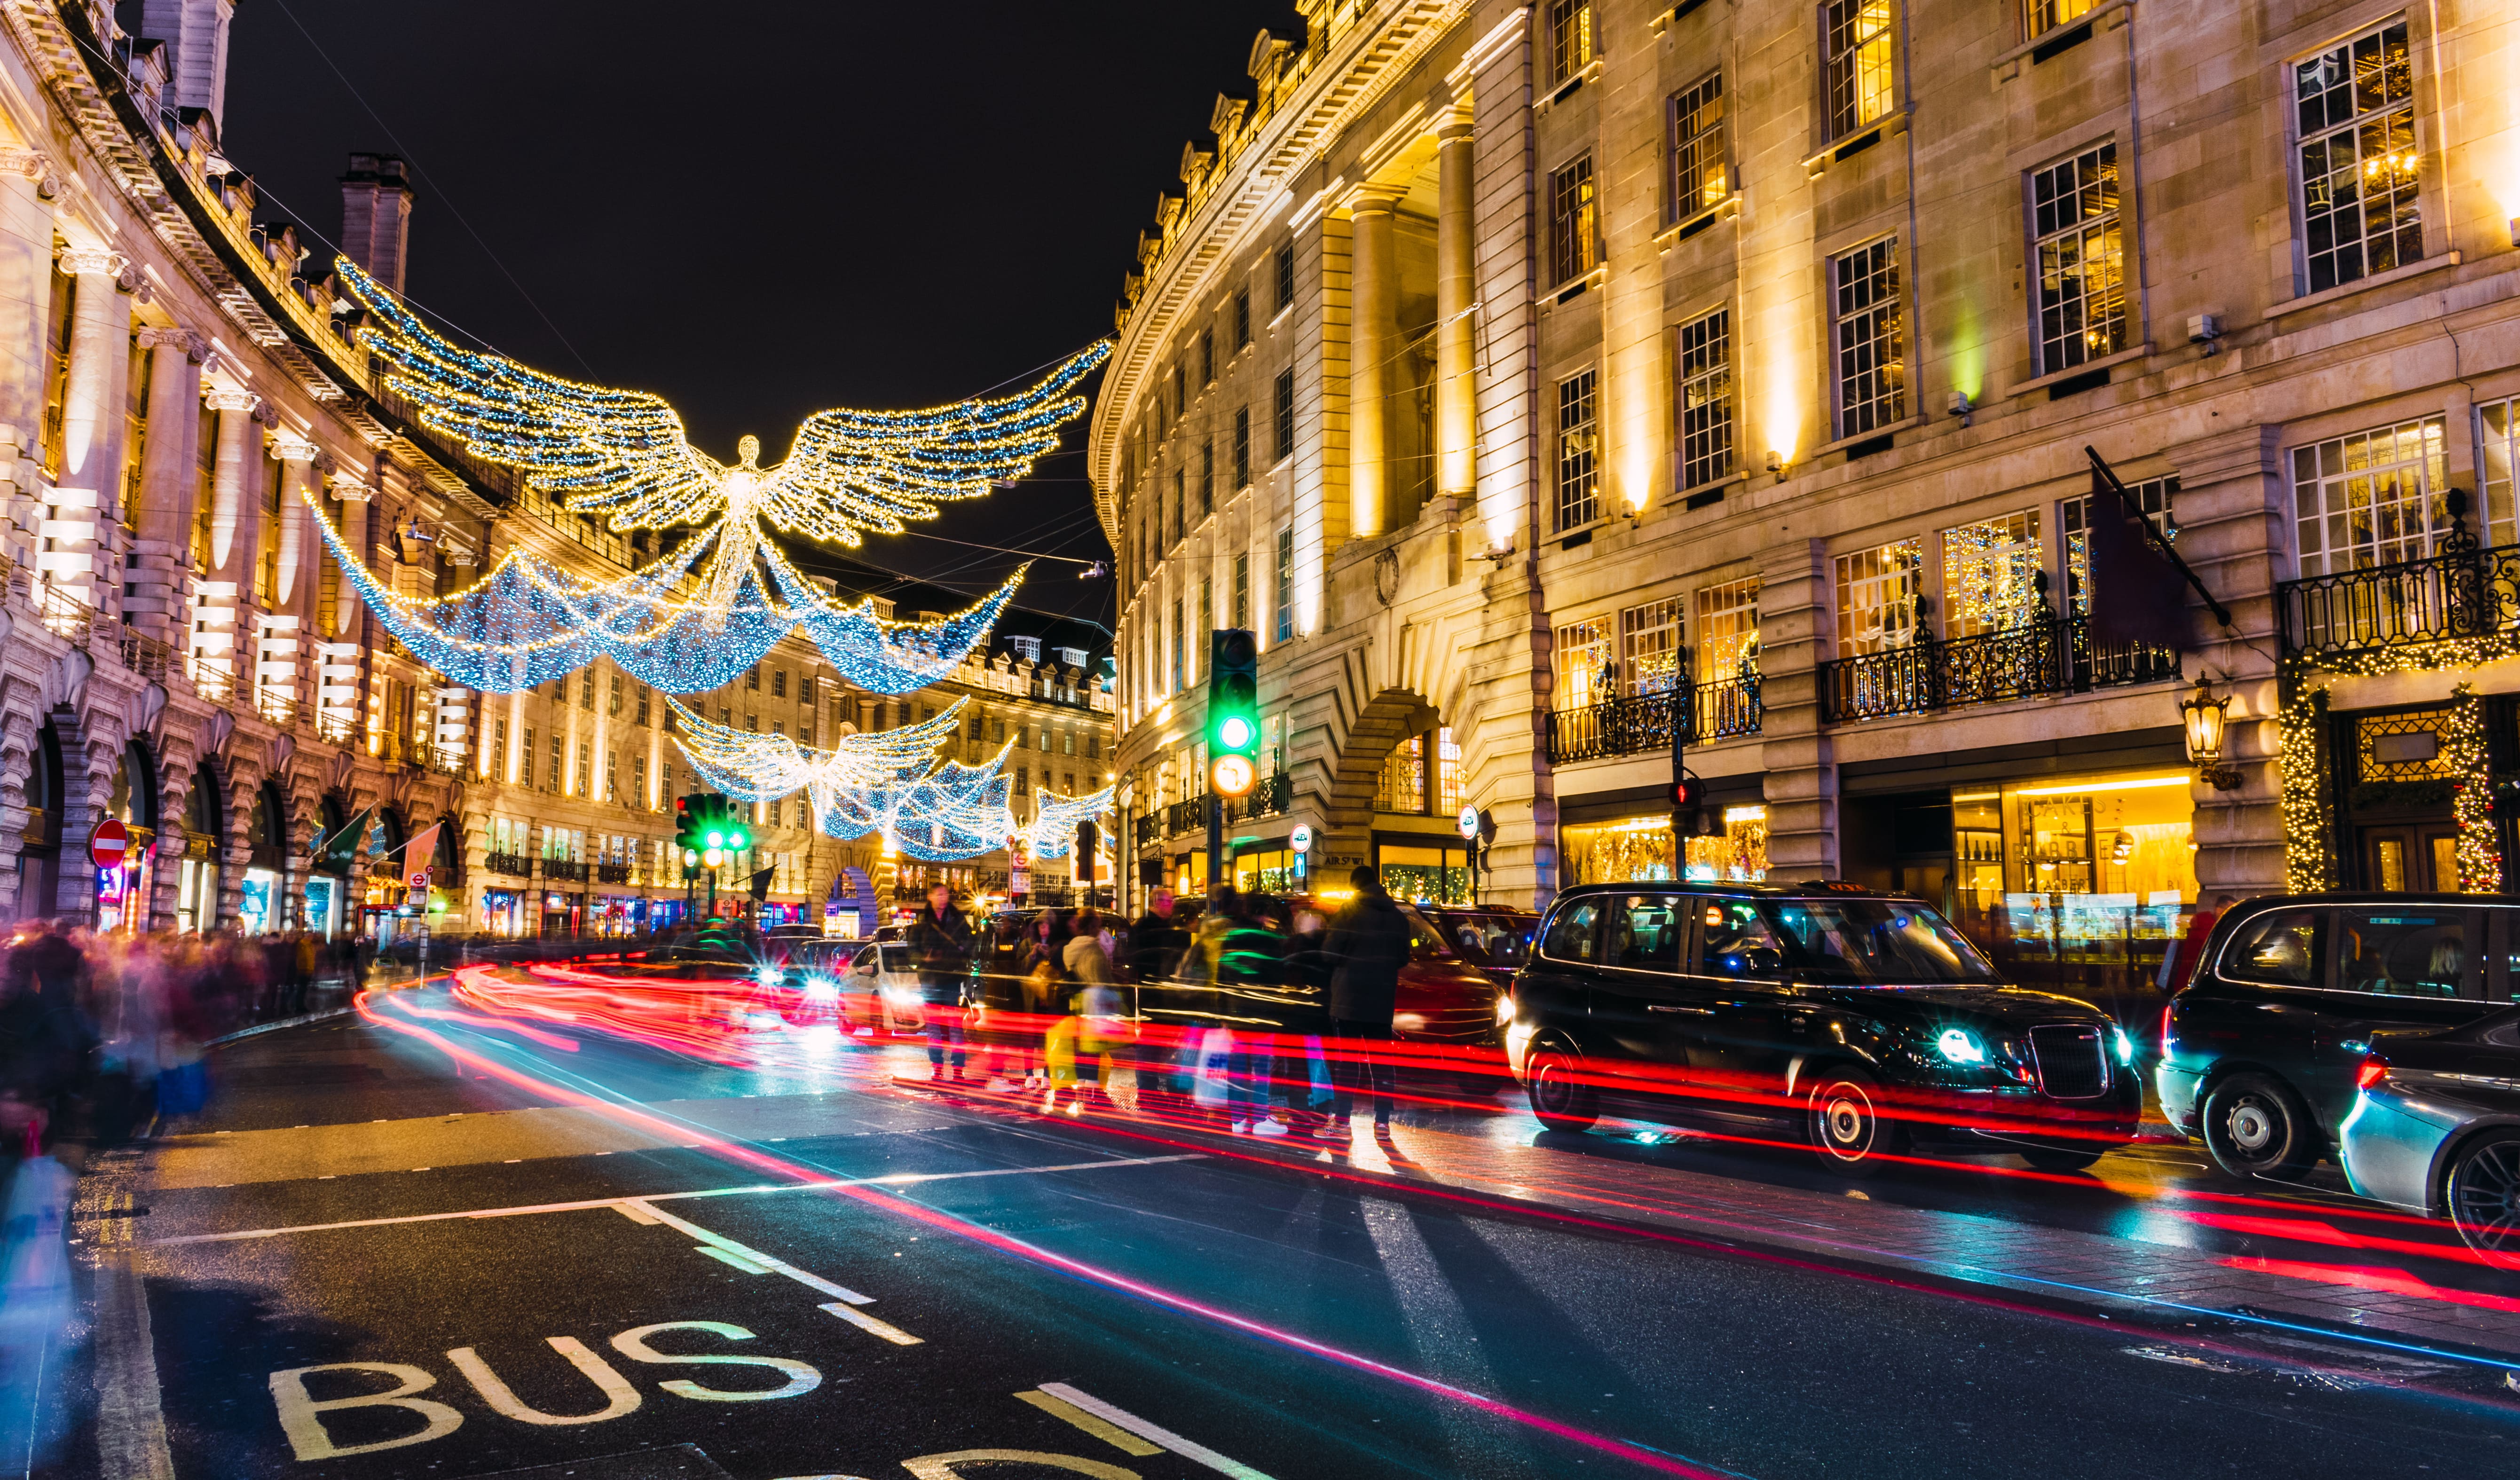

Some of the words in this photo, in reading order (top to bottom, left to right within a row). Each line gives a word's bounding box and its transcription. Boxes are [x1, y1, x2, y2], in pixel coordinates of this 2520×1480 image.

[2026, 793, 2106, 817] CAKES
[2062, 821, 2070, 834] &
[1325, 857, 1339, 865] AIR
[2013, 838, 2125, 863] BUBBLES
[269, 1321, 822, 1461] BUS
